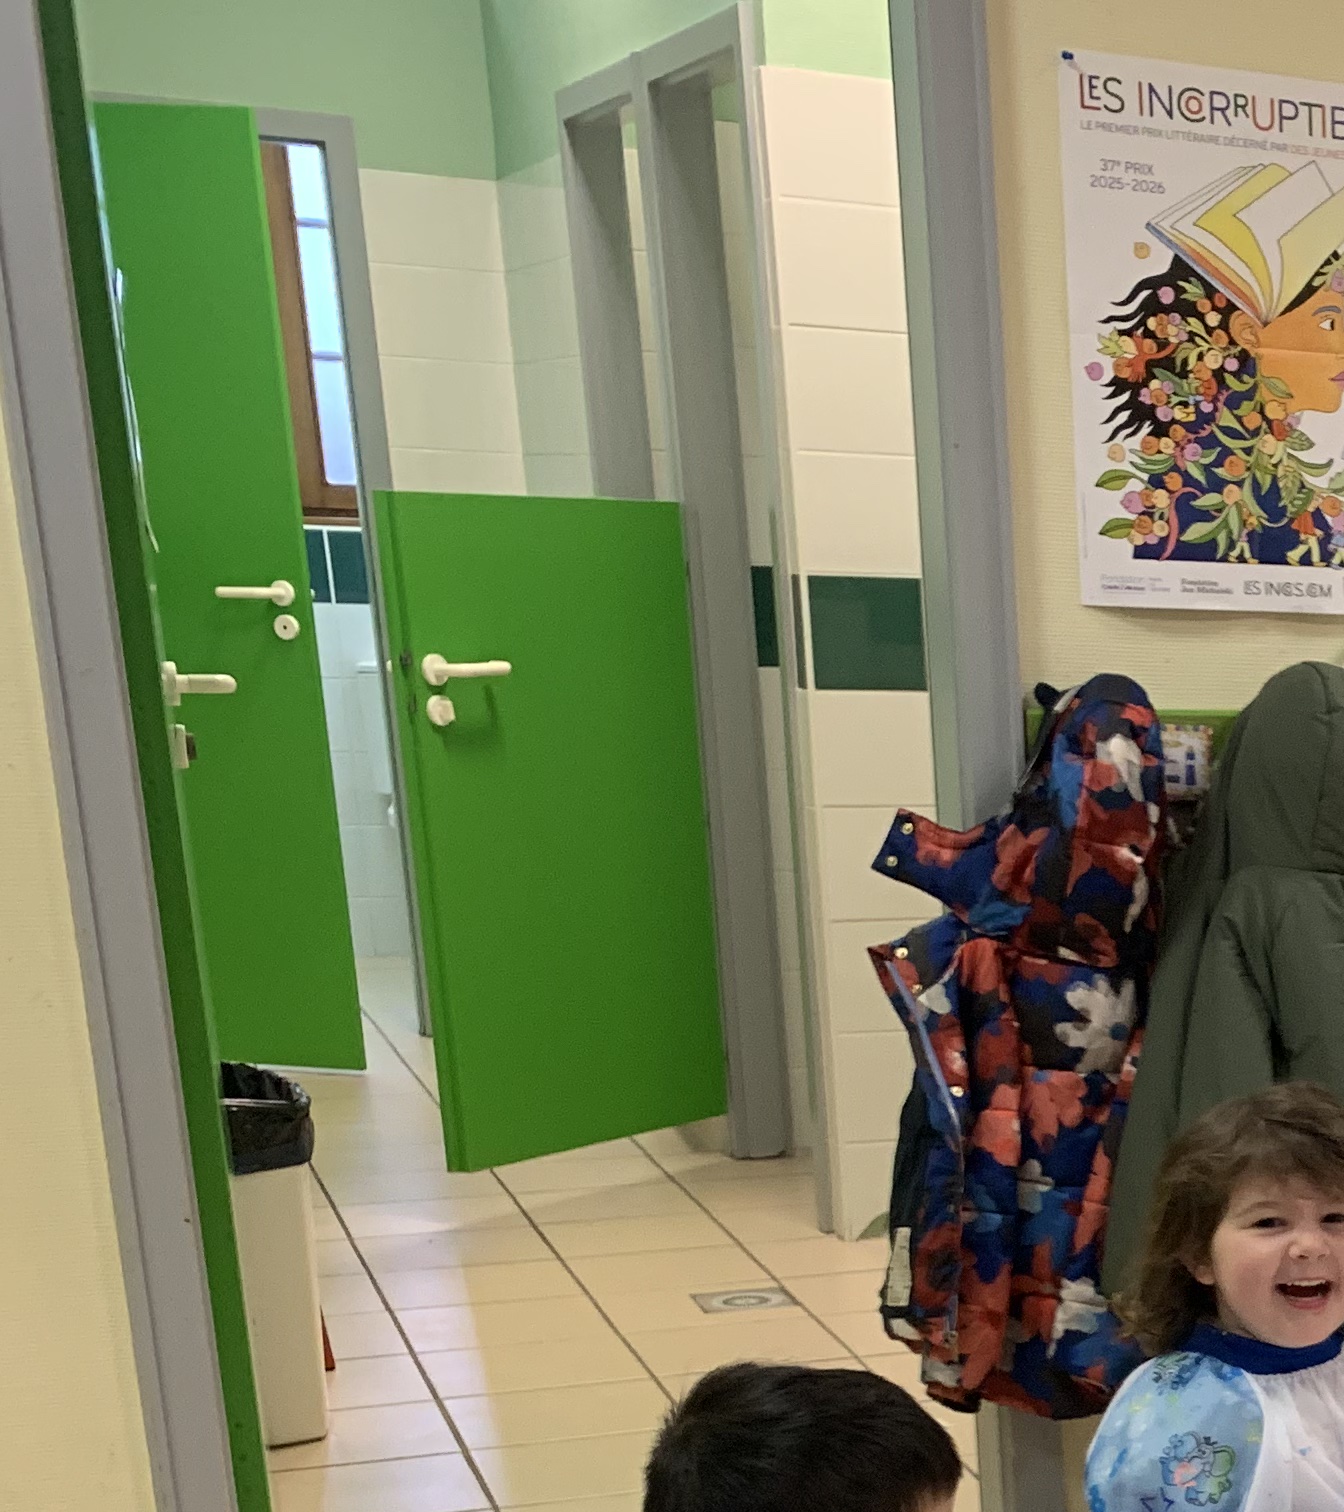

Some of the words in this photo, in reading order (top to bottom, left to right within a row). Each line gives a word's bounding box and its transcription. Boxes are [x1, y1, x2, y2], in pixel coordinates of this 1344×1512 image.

[1078, 73, 1125, 114] LES
[1079, 119, 1093, 130] LE
[1095, 121, 1140, 136] PREMIER
[1124, 160, 1155, 176] PRIX
[1089, 174, 1166, 195] 2025-2026
